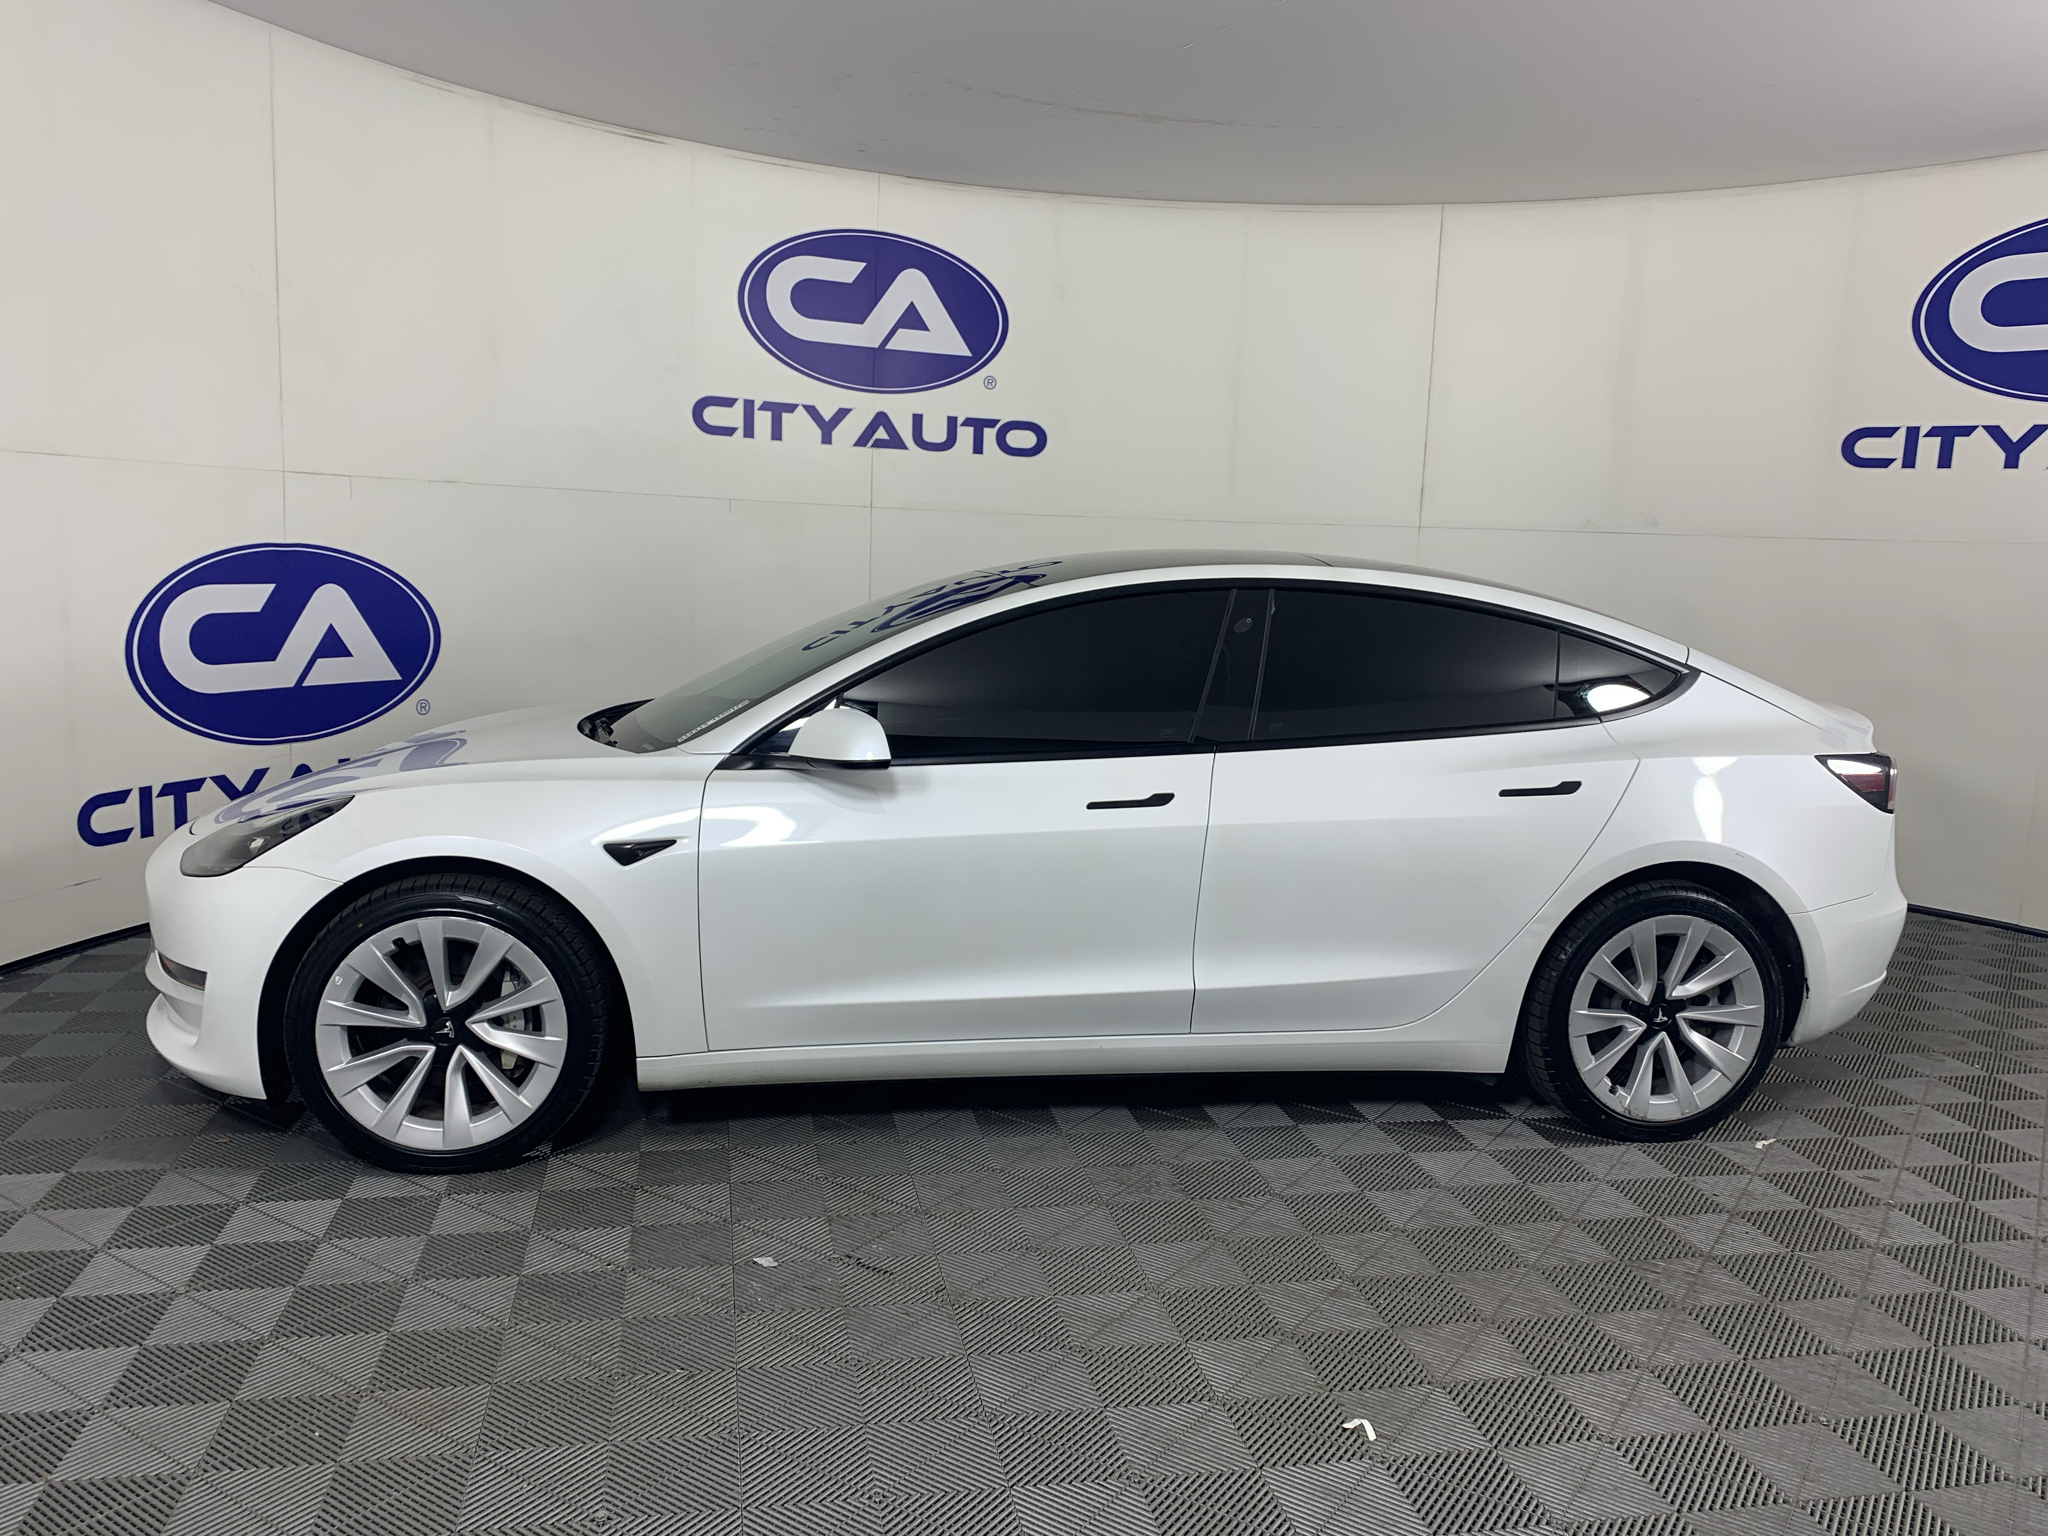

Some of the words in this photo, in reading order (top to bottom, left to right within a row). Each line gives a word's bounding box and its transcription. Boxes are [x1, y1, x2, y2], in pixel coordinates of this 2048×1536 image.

[766, 255, 973, 357] CA
[692, 395, 853, 446] CITY
[852, 410, 1048, 457] AUTO
[1841, 424, 2048, 469] CITY
[159, 583, 402, 693] CA
